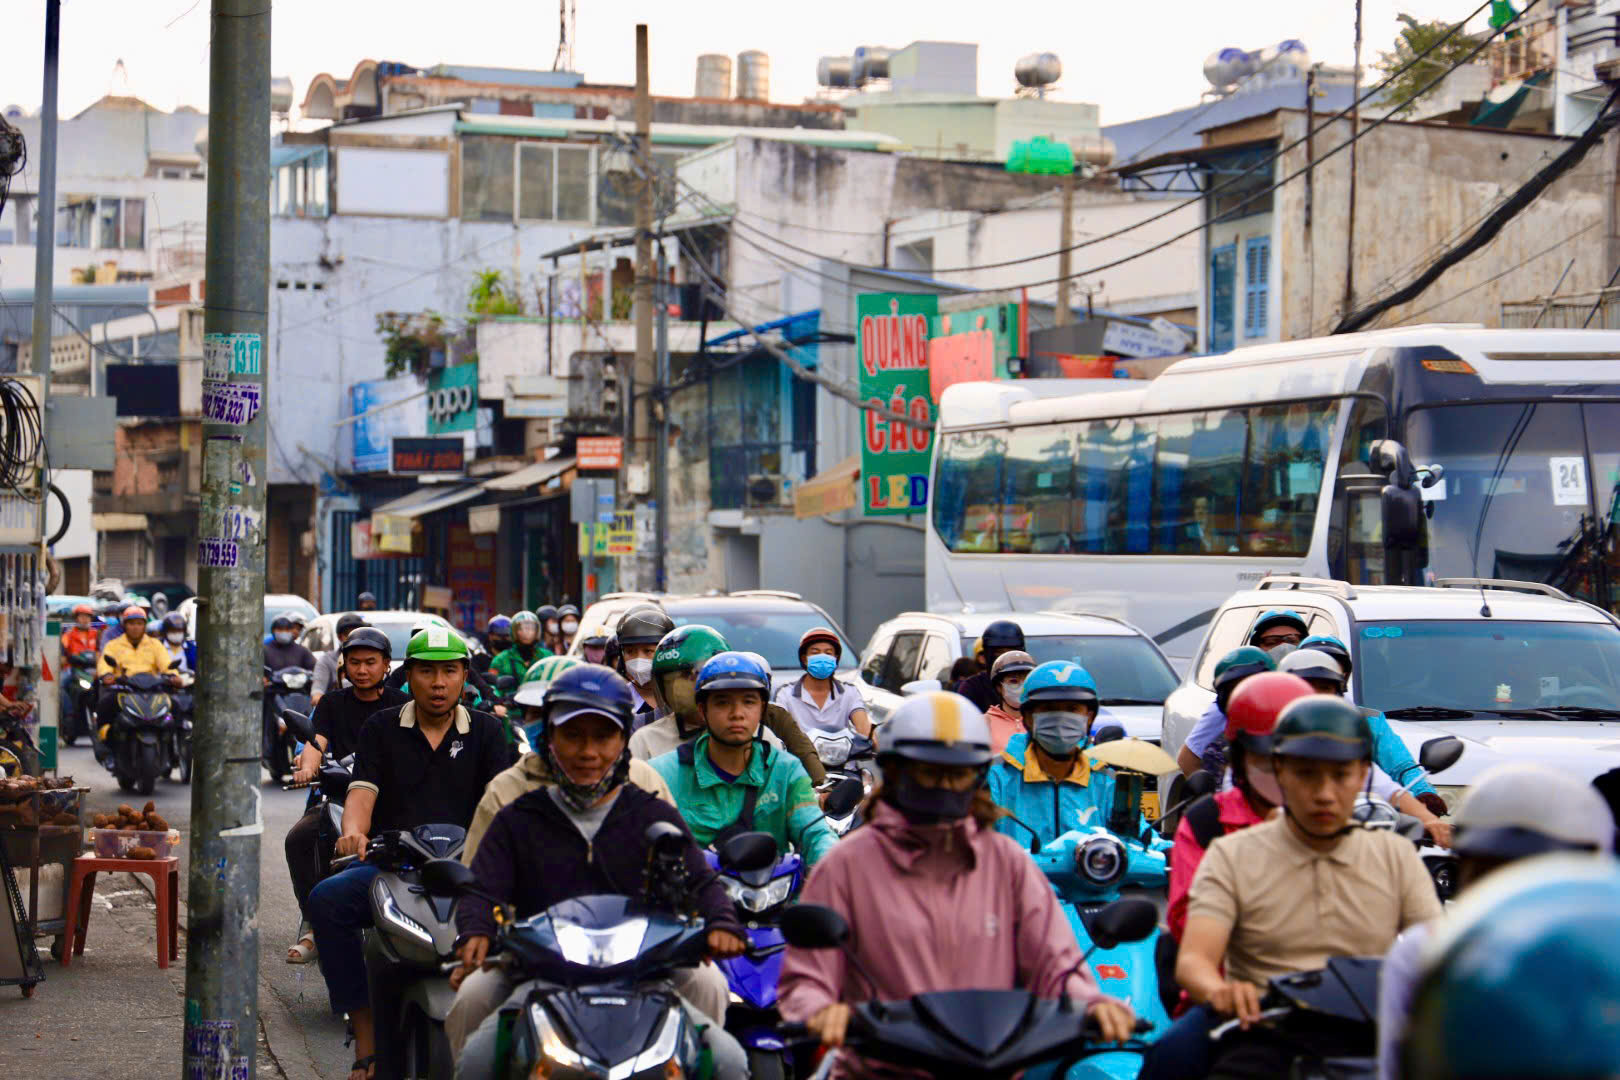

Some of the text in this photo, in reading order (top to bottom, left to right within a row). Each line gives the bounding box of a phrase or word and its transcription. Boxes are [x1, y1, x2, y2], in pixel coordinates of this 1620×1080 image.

[862, 298, 928, 376] QUẢNG
[866, 384, 930, 454] CÁO
[869, 474, 928, 509] LED
[1560, 464, 1578, 488] 24
[656, 649, 680, 661] Grab
